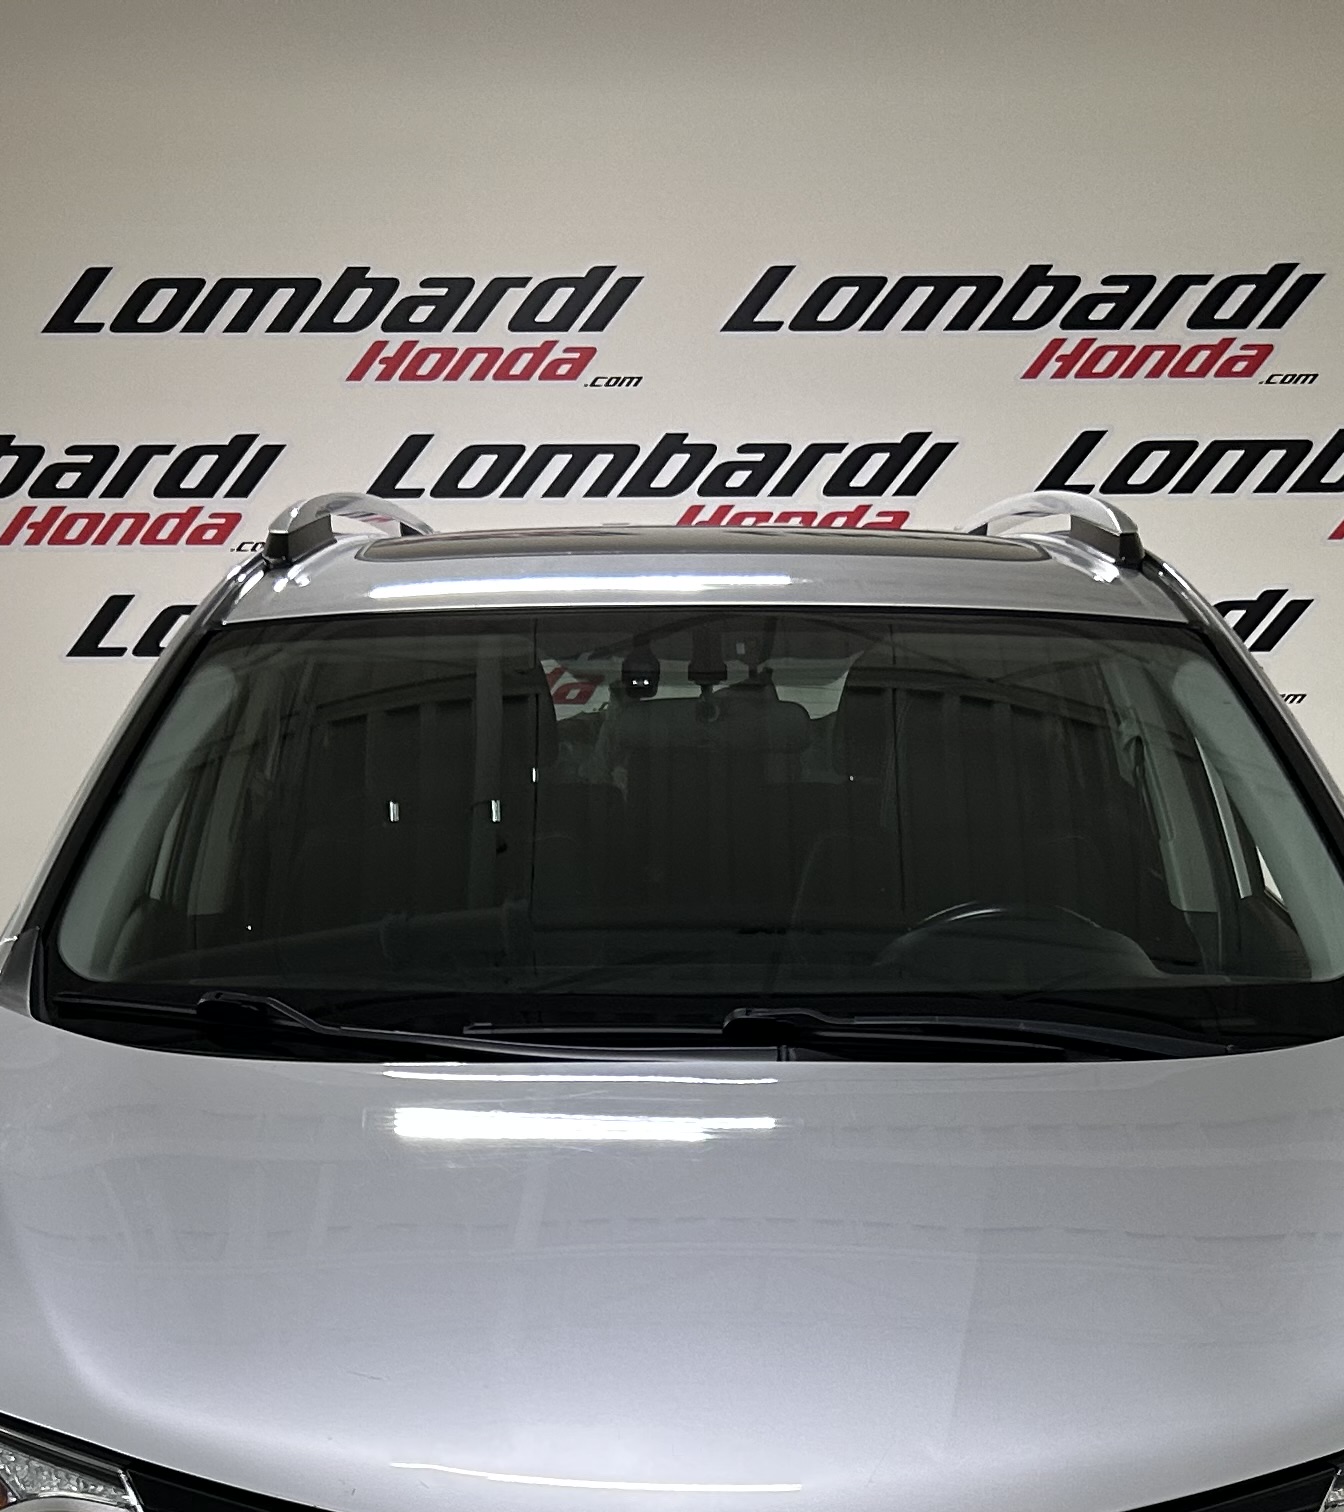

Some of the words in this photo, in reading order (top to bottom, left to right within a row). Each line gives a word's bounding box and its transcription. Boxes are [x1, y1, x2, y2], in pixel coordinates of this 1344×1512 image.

[40, 266, 645, 333] Lombardi
[719, 264, 1327, 332] Lombardi
[346, 340, 598, 381] Honda
[1021, 337, 1275, 379] Honda
[1258, 373, 1320, 385] .com
[583, 376, 644, 388] .com
[365, 432, 960, 499] Lombardi
